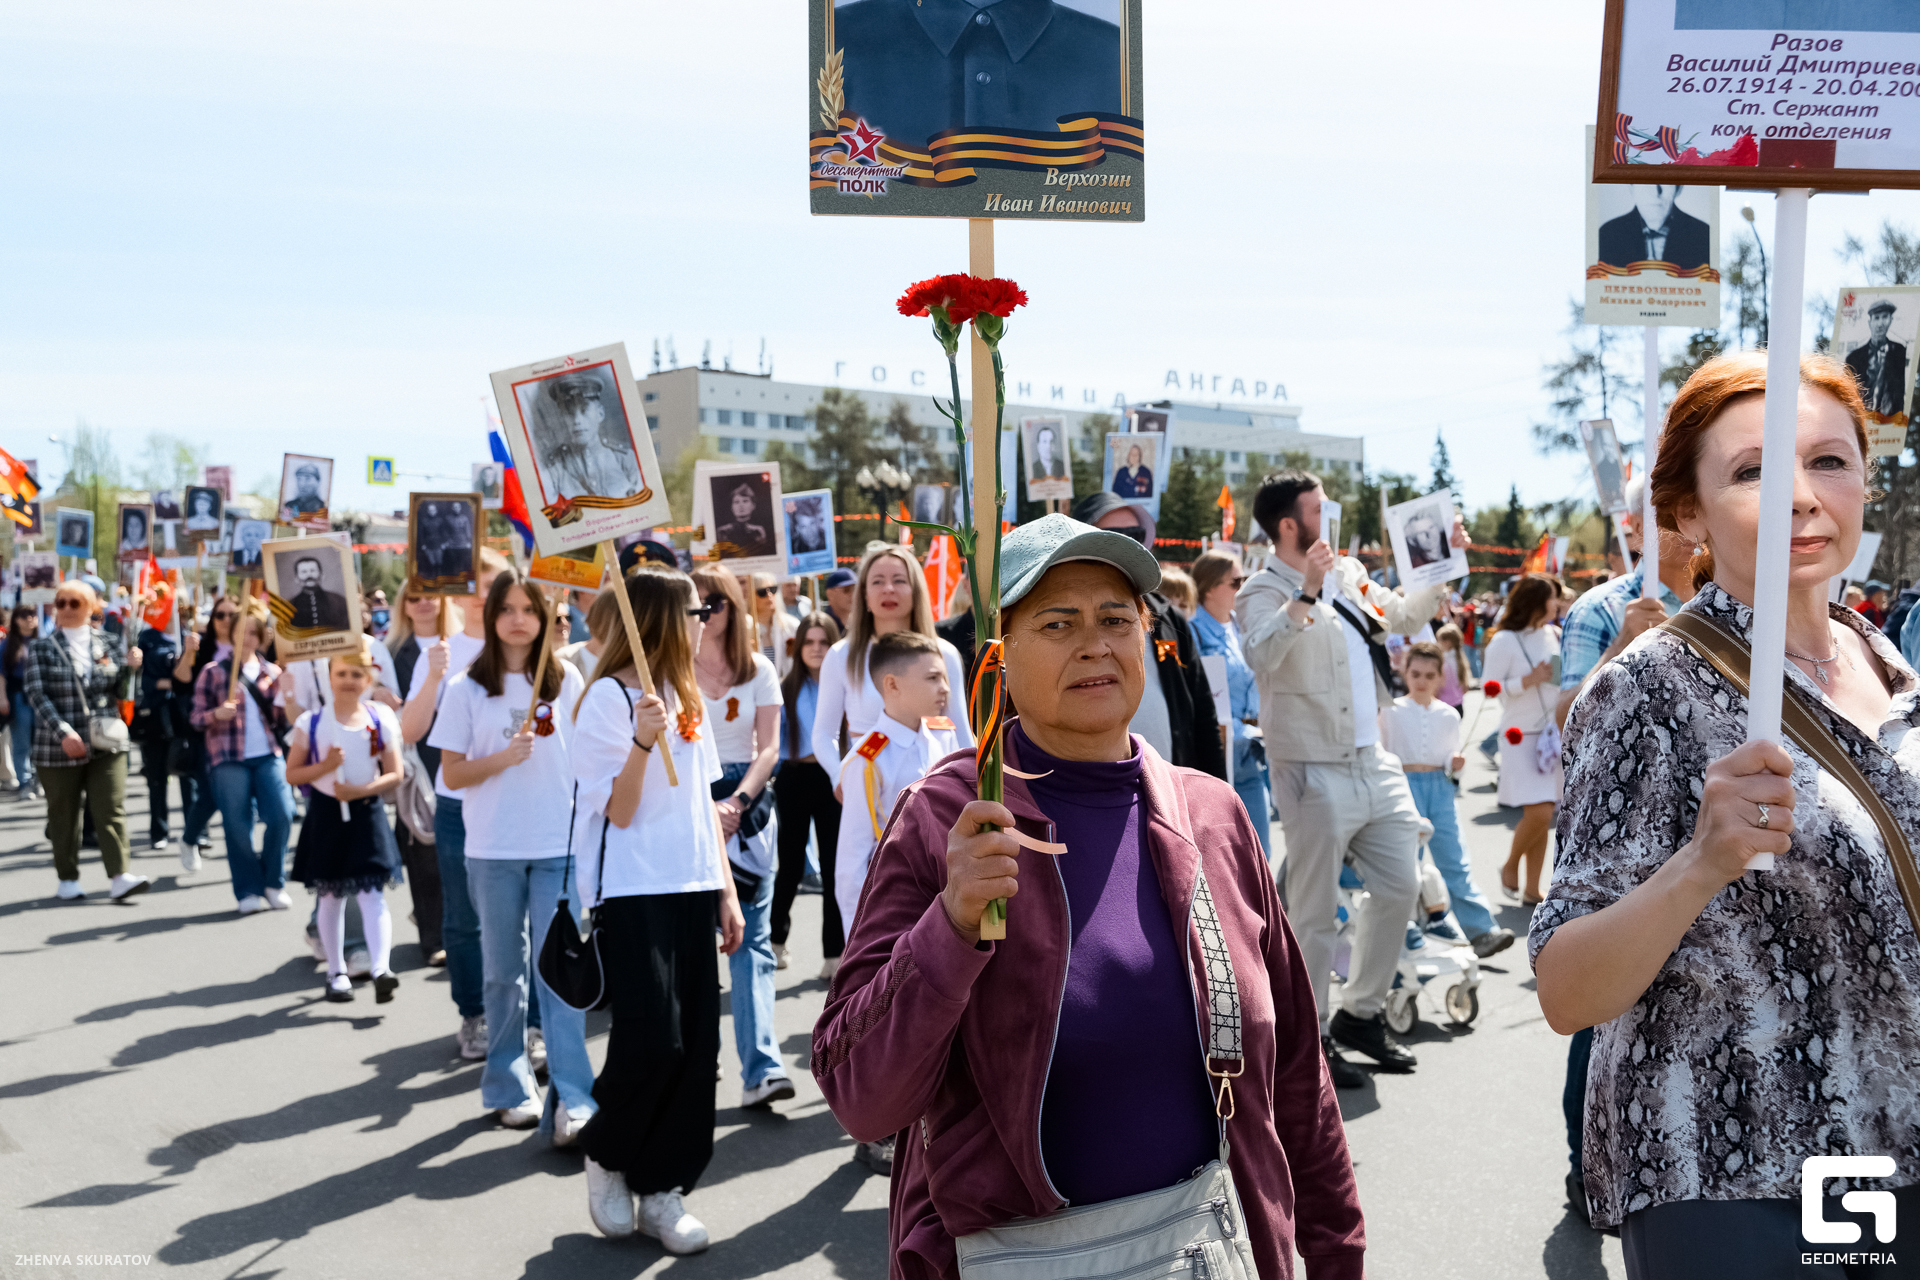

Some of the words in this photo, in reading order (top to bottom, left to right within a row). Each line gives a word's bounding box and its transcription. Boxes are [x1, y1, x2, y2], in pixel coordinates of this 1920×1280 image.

[1769, 33, 1843, 52] Разов
[1665, 54, 1772, 72] Василий
[1666, 77, 1793, 94] 26.07.1914
[1726, 98, 1766, 116] Ст.
[1772, 99, 1879, 120] Сержант
[1764, 121, 1892, 140] отделения
[839, 179, 886, 193] ПОЛК
[1043, 167, 1132, 191] Верхозин
[983, 193, 1033, 212] Иван
[1038, 194, 1132, 214] Иванович
[835, 361, 1127, 408] ГОСНИЦА
[1165, 369, 1289, 401] АНГАРА
